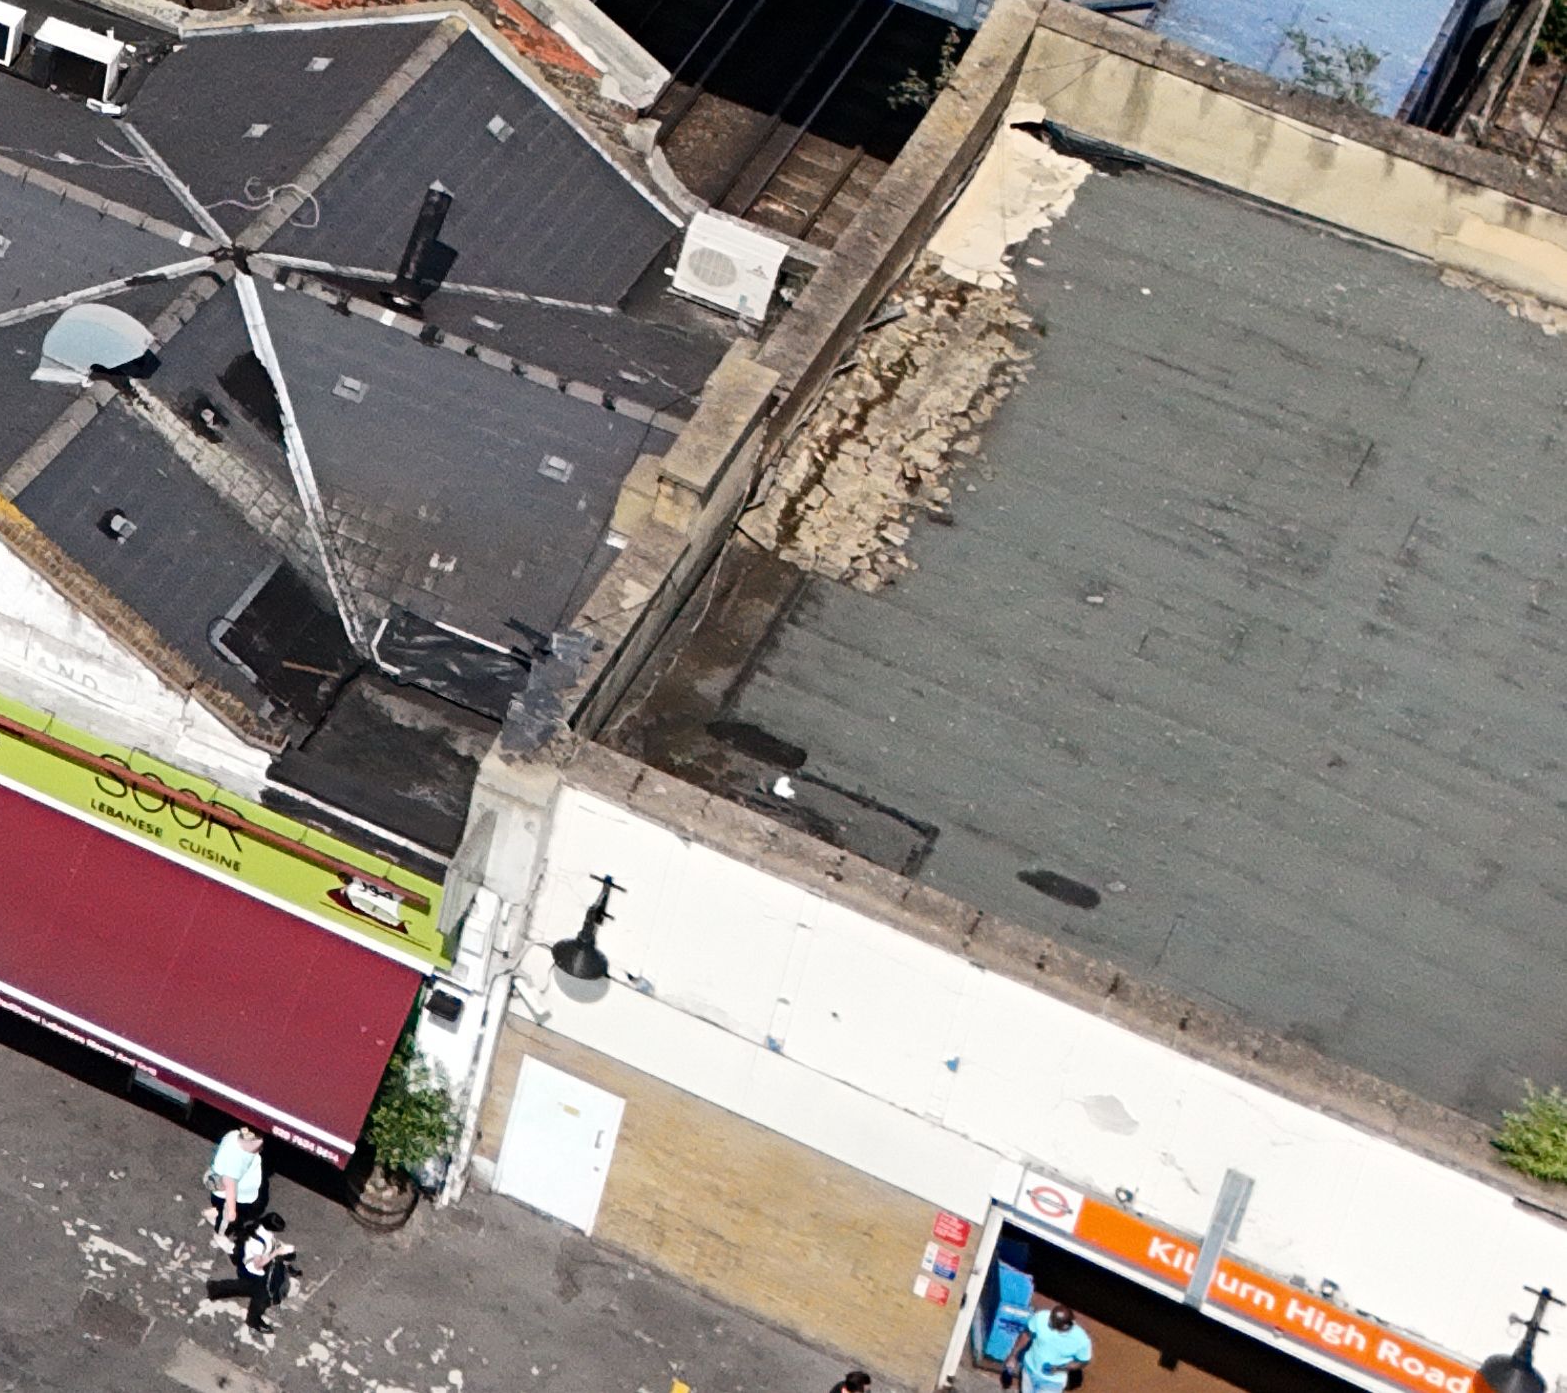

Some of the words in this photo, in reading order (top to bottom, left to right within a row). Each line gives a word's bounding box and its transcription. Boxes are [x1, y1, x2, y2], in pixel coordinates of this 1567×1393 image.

[90, 798, 164, 838] LEBANESE
[178, 837, 243, 873] CUISINE
[94, 753, 243, 853] SOOR
[1148, 1236, 1276, 1312] Kilurn
[1286, 1297, 1366, 1352] High
[1376, 1338, 1472, 1393] Road
